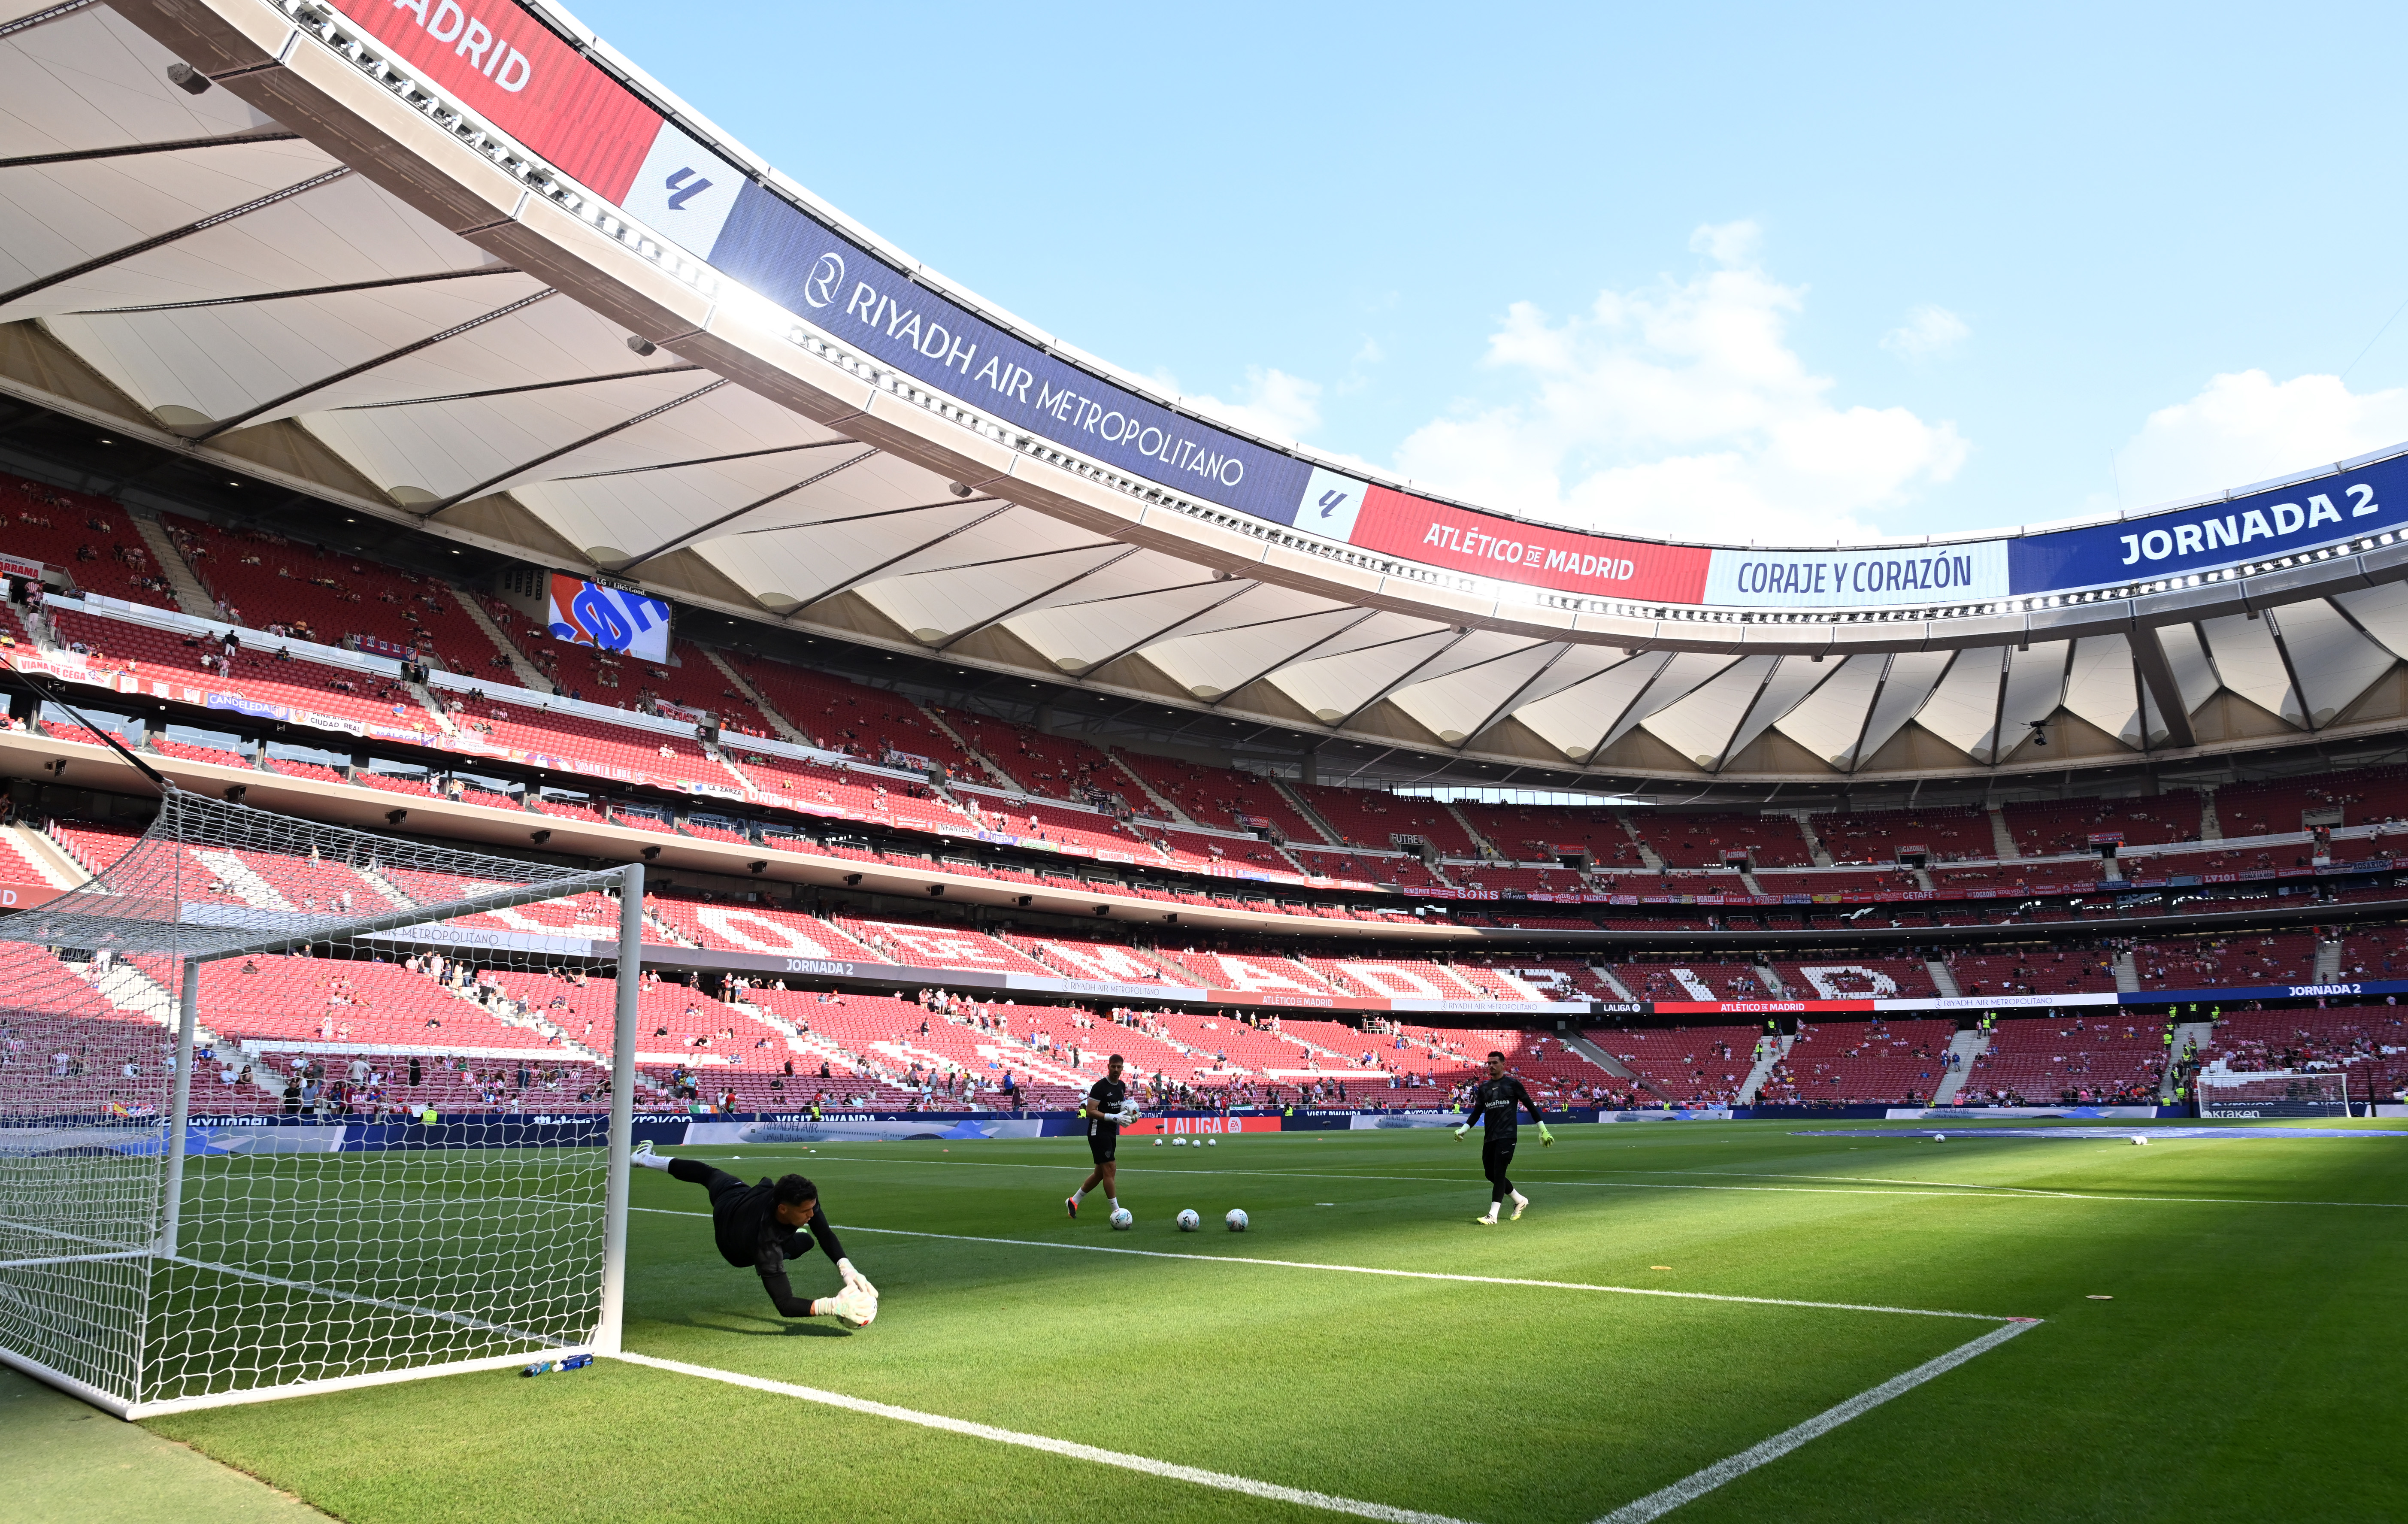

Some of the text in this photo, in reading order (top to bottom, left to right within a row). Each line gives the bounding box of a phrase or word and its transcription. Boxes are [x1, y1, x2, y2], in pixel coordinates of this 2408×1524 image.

[846, 281, 1244, 486] RIYADH AIR METROPOLITANO
[2120, 484, 2379, 565] JORNADA 2
[1423, 523, 1634, 581] ATLÉTICO DE MADRID
[1739, 551, 1971, 594] CORAJE Y CORAZÓN
[614, 582, 628, 591] Life's
[629, 587, 646, 596] Good.
[21, 660, 48, 670] VIANA
[51, 665, 61, 676] DE
[63, 669, 86, 681] CEGA
[209, 695, 270, 712] CANDELEDA
[310, 717, 360, 733] CIUDAD REAL
[376, 730, 418, 742] MÁLAGA
[585, 762, 610, 776] SANTA
[720, 787, 742, 796] ZARZA
[872, 815, 889, 823] latido
[938, 824, 969, 833] INFANTES
[2353, 860, 2384, 870] ROSARIO
[2205, 873, 2236, 882] LV101
[1457, 889, 1499, 900] SONS
[1760, 895, 1781, 904] SONSECA
[402, 927, 499, 945] METROPOLITANO
[786, 958, 854, 975] JORNADA 2
[1071, 982, 1160, 996] RIYADH AIR METROPOLITANO
[2288, 984, 2362, 996] JORNADA 2
[1263, 994, 1296, 1005] ATLÉTICO
[1303, 998, 1333, 1007] MADRID
[1720, 1002, 1760, 1012] ATLÉTICO
[1769, 1003, 1805, 1011] MADRID
[1991, 997, 2053, 1005] METROPOLITANO
[763, 1122, 819, 1133] RIYADH AIR
[1164, 1117, 1222, 1134] LALIGA
